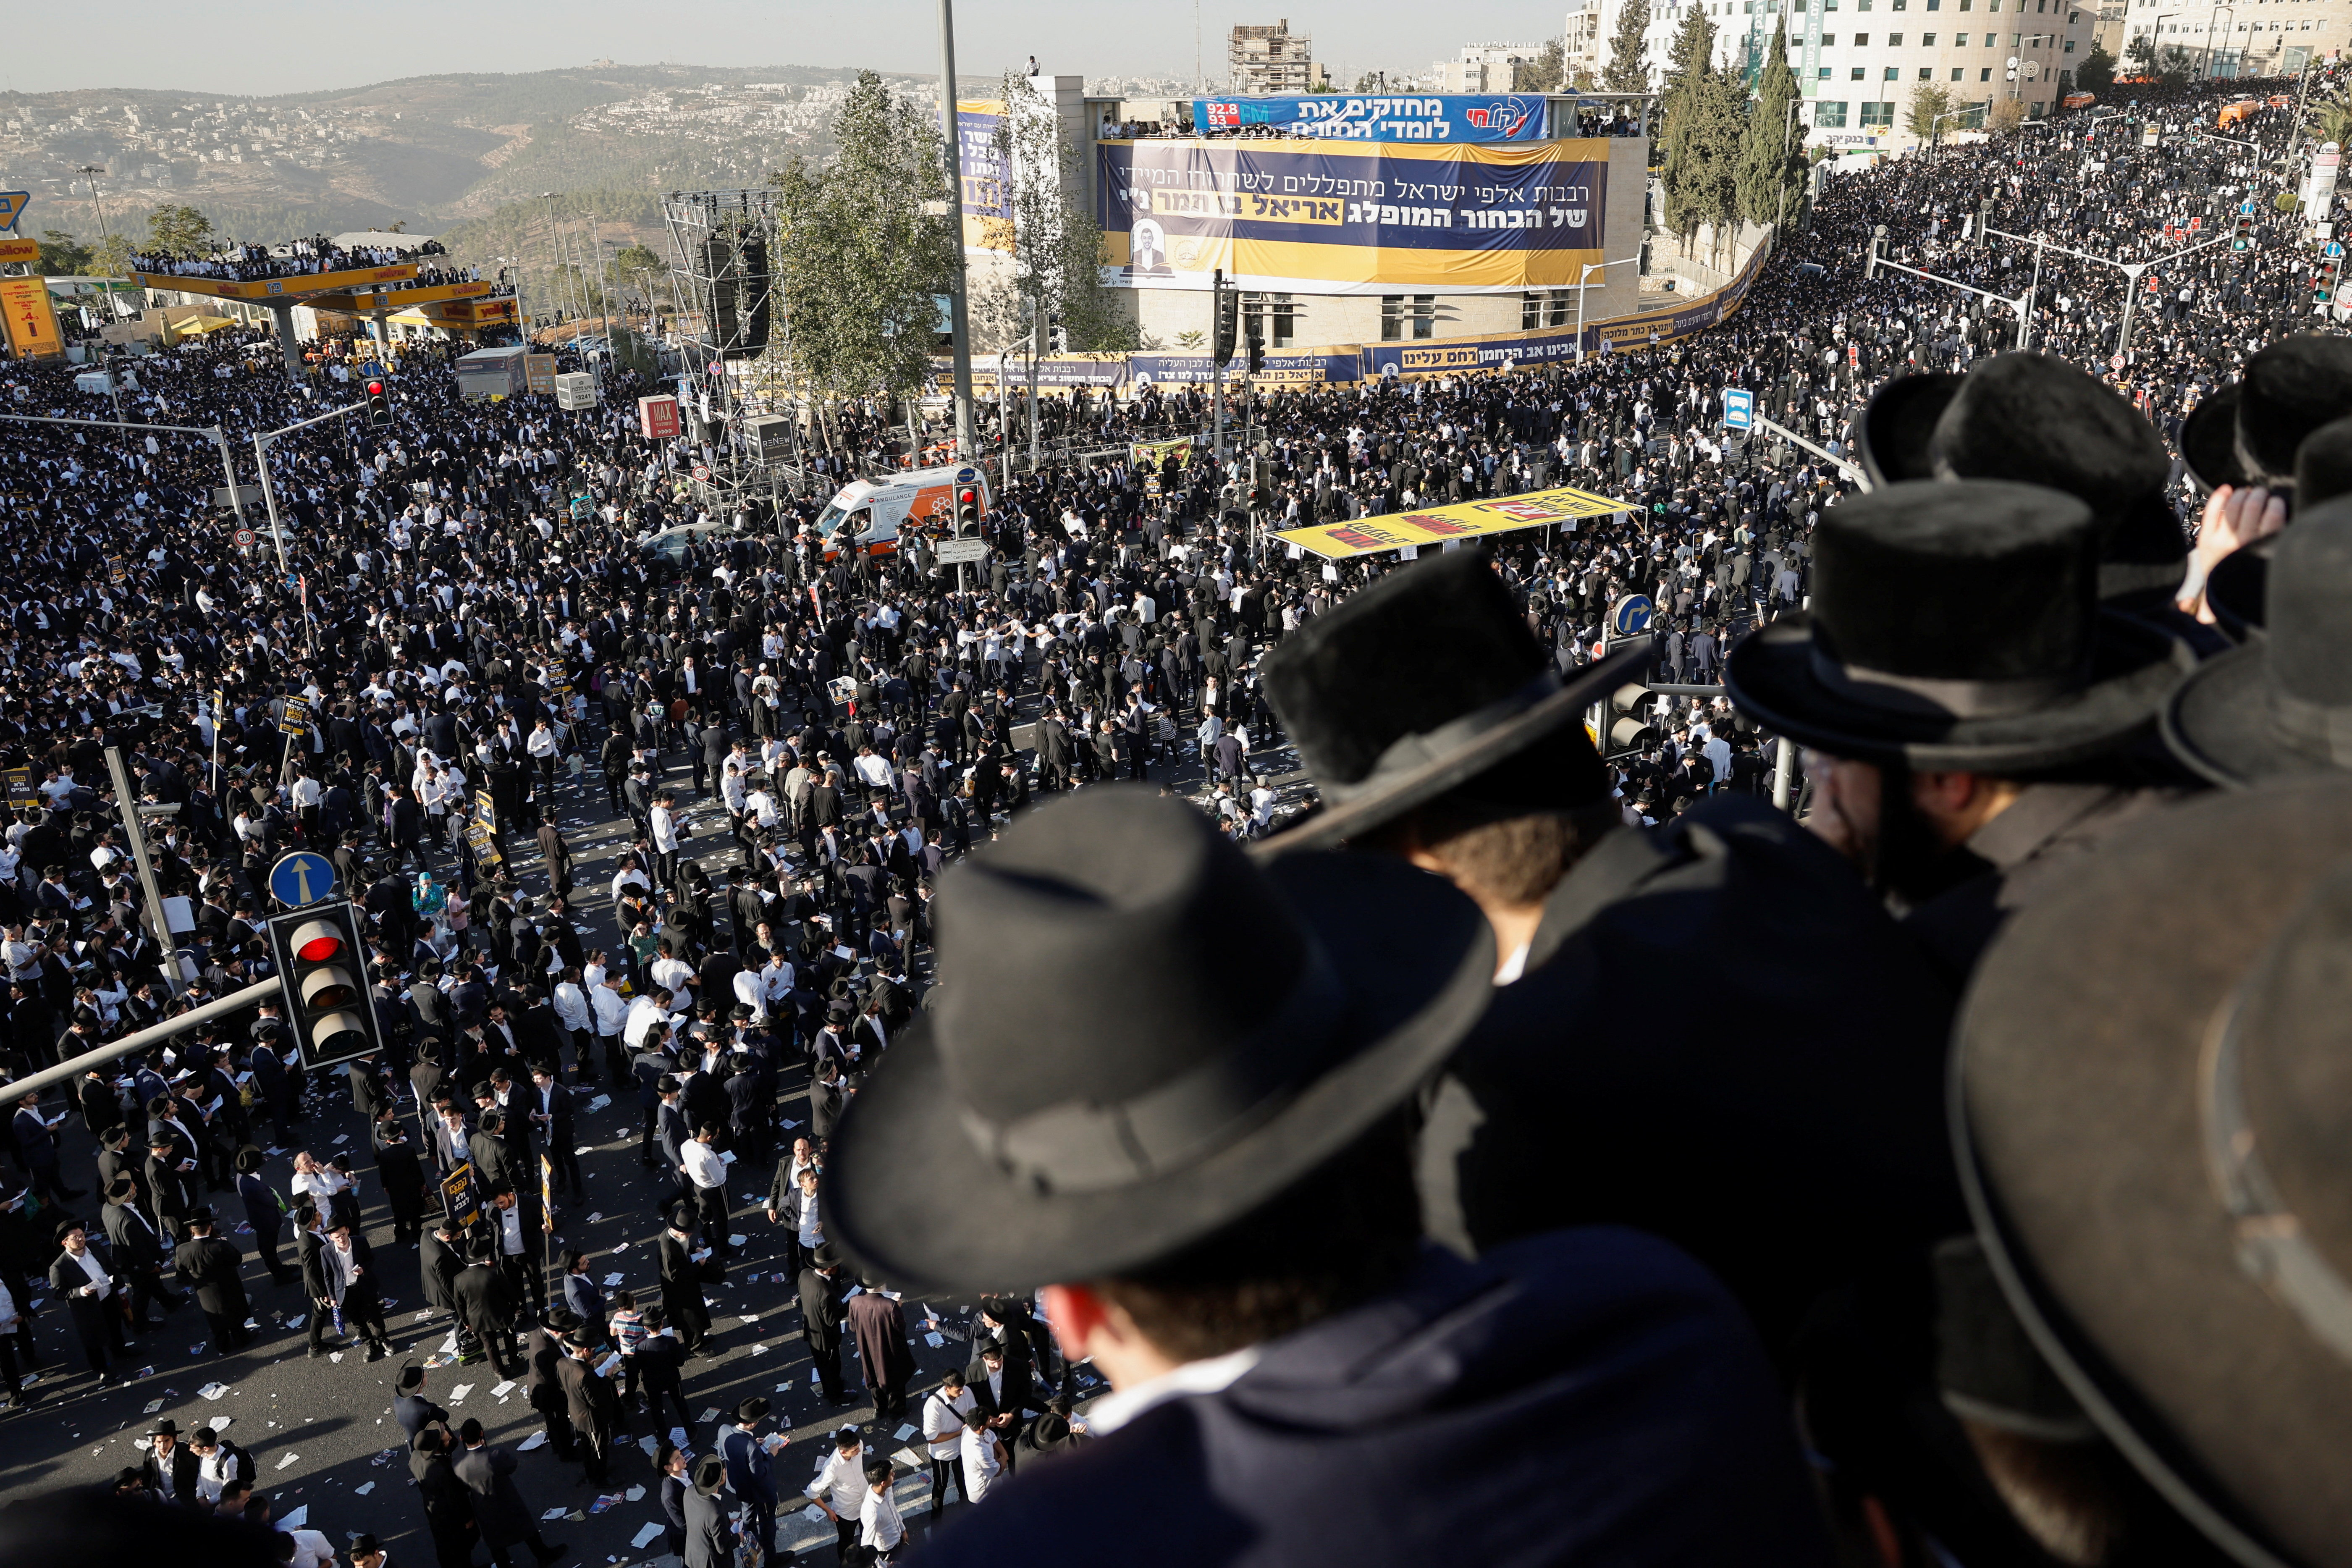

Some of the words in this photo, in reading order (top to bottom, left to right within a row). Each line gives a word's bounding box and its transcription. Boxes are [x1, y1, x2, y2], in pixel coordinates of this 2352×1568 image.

[1755, 5, 1764, 30] בנק
[1207, 103, 1238, 115] 92.8
[1240, 105, 1269, 124] FM
[1298, 101, 1338, 117] את
[1346, 99, 1442, 119] מחזקים
[1209, 115, 1226, 125] 93
[1292, 121, 1372, 138] התורה
[1381, 118, 1450, 138] לומדי
[965, 130, 993, 144] שר
[1826, 135, 1843, 144] יהב
[1845, 136, 1864, 144] בנק
[1120, 167, 1179, 185] המיידי
[1188, 170, 1274, 190] לשחרורו
[1283, 173, 1385, 197] מתפללים
[1394, 178, 1465, 202] ישראל
[1475, 184, 1524, 203] אלפי
[1533, 186, 1589, 202] רבבות
[1157, 192, 1209, 213] תמר
[1218, 195, 1243, 216] בן
[1252, 194, 1339, 220] אריאל
[1348, 200, 1452, 228] המופלג
[1461, 209, 1542, 228] הבחור
[1550, 206, 1587, 228] של
[0, 245, 33, 256] ellow
[375, 268, 407, 280] yellow
[266, 282, 283, 293] פז
[453, 284, 482, 295] yellow
[1602, 328, 1628, 339] מלוכה!
[1631, 326, 1645, 336] כתר
[1447, 349, 1476, 363] רחם
[1479, 346, 1523, 364] הרחמן
[1527, 346, 1544, 357] אב
[1547, 342, 1577, 356] אבינו
[1159, 359, 1185, 368] העליה
[1189, 359, 1203, 369] לבן
[1272, 359, 1295, 367] אלפי
[1298, 359, 1327, 367] רבבות
[1404, 351, 1442, 365] עלינו
[1158, 371, 1176, 379] צר!
[1178, 370, 1193, 379] לנו
[1275, 372, 1285, 380] בן
[653, 403, 672, 422] MAX
[763, 437, 789, 447] RENEW
[876, 493, 912, 503] AMBULANCE
[239, 533, 251, 542] 30
[286, 703, 306, 712] הישיבות
[289, 698, 304, 706] סגירת
[285, 716, 302, 725] ליהדות
[451, 1178, 467, 1192] לכלא
[454, 1196, 469, 1211] לצבא
[456, 1192, 466, 1202] ולא
